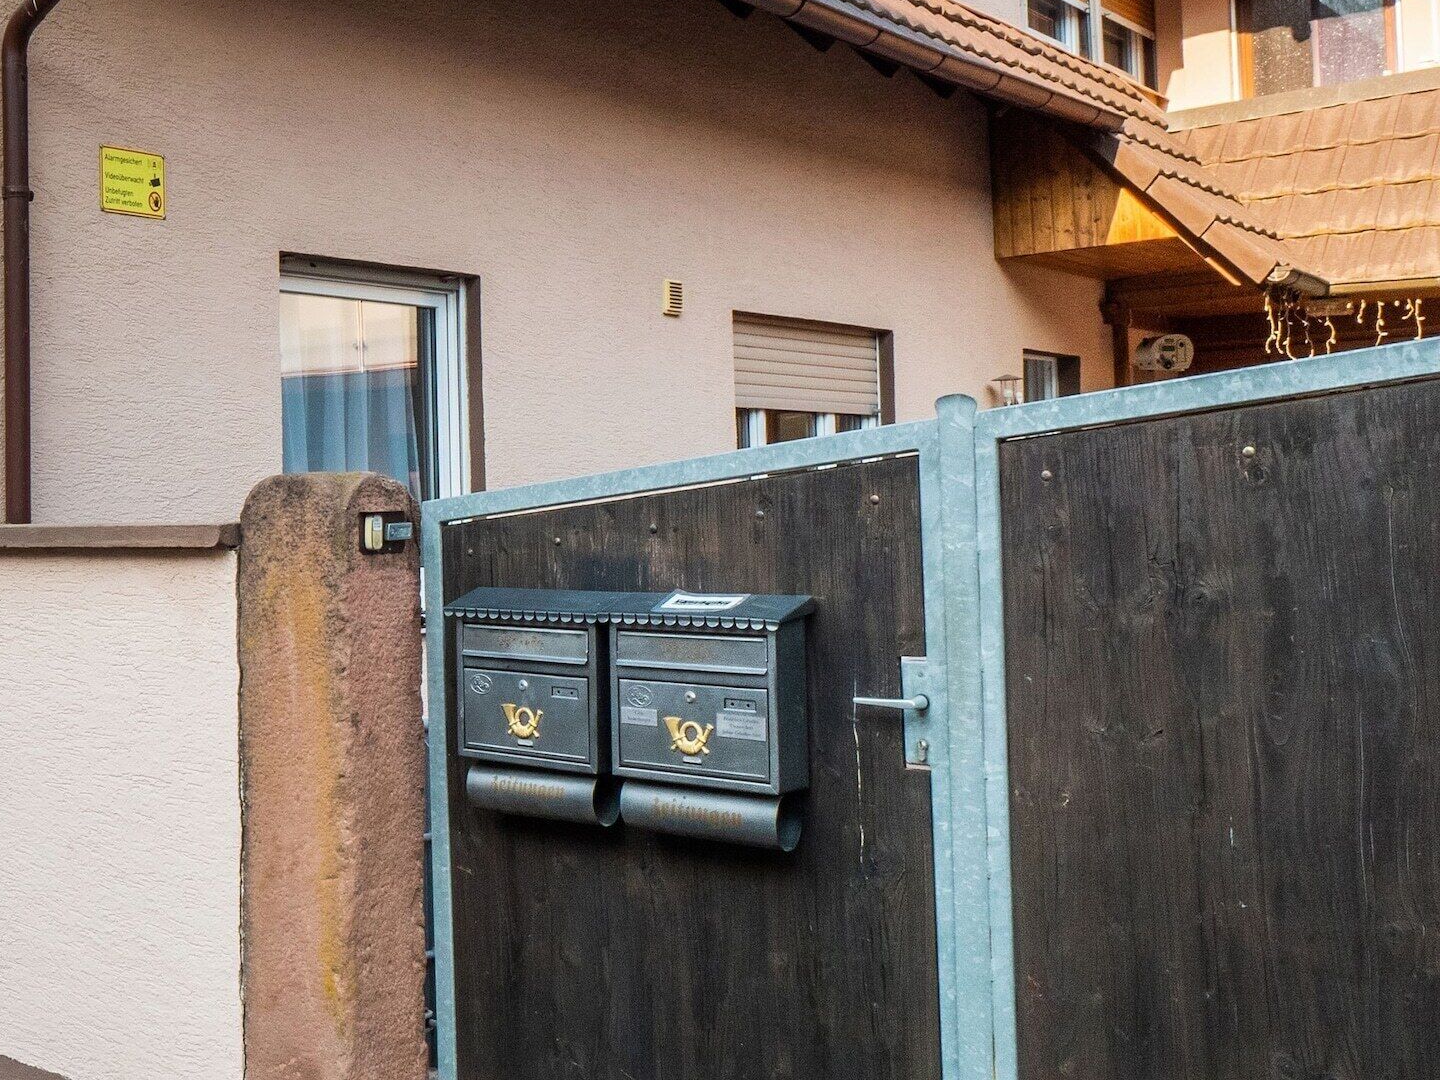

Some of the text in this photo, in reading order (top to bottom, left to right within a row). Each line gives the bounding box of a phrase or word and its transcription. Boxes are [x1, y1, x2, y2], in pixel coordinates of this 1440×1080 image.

[104, 172, 144, 184] Videoüberwacht
[105, 196, 143, 208] Zutritt verboten
